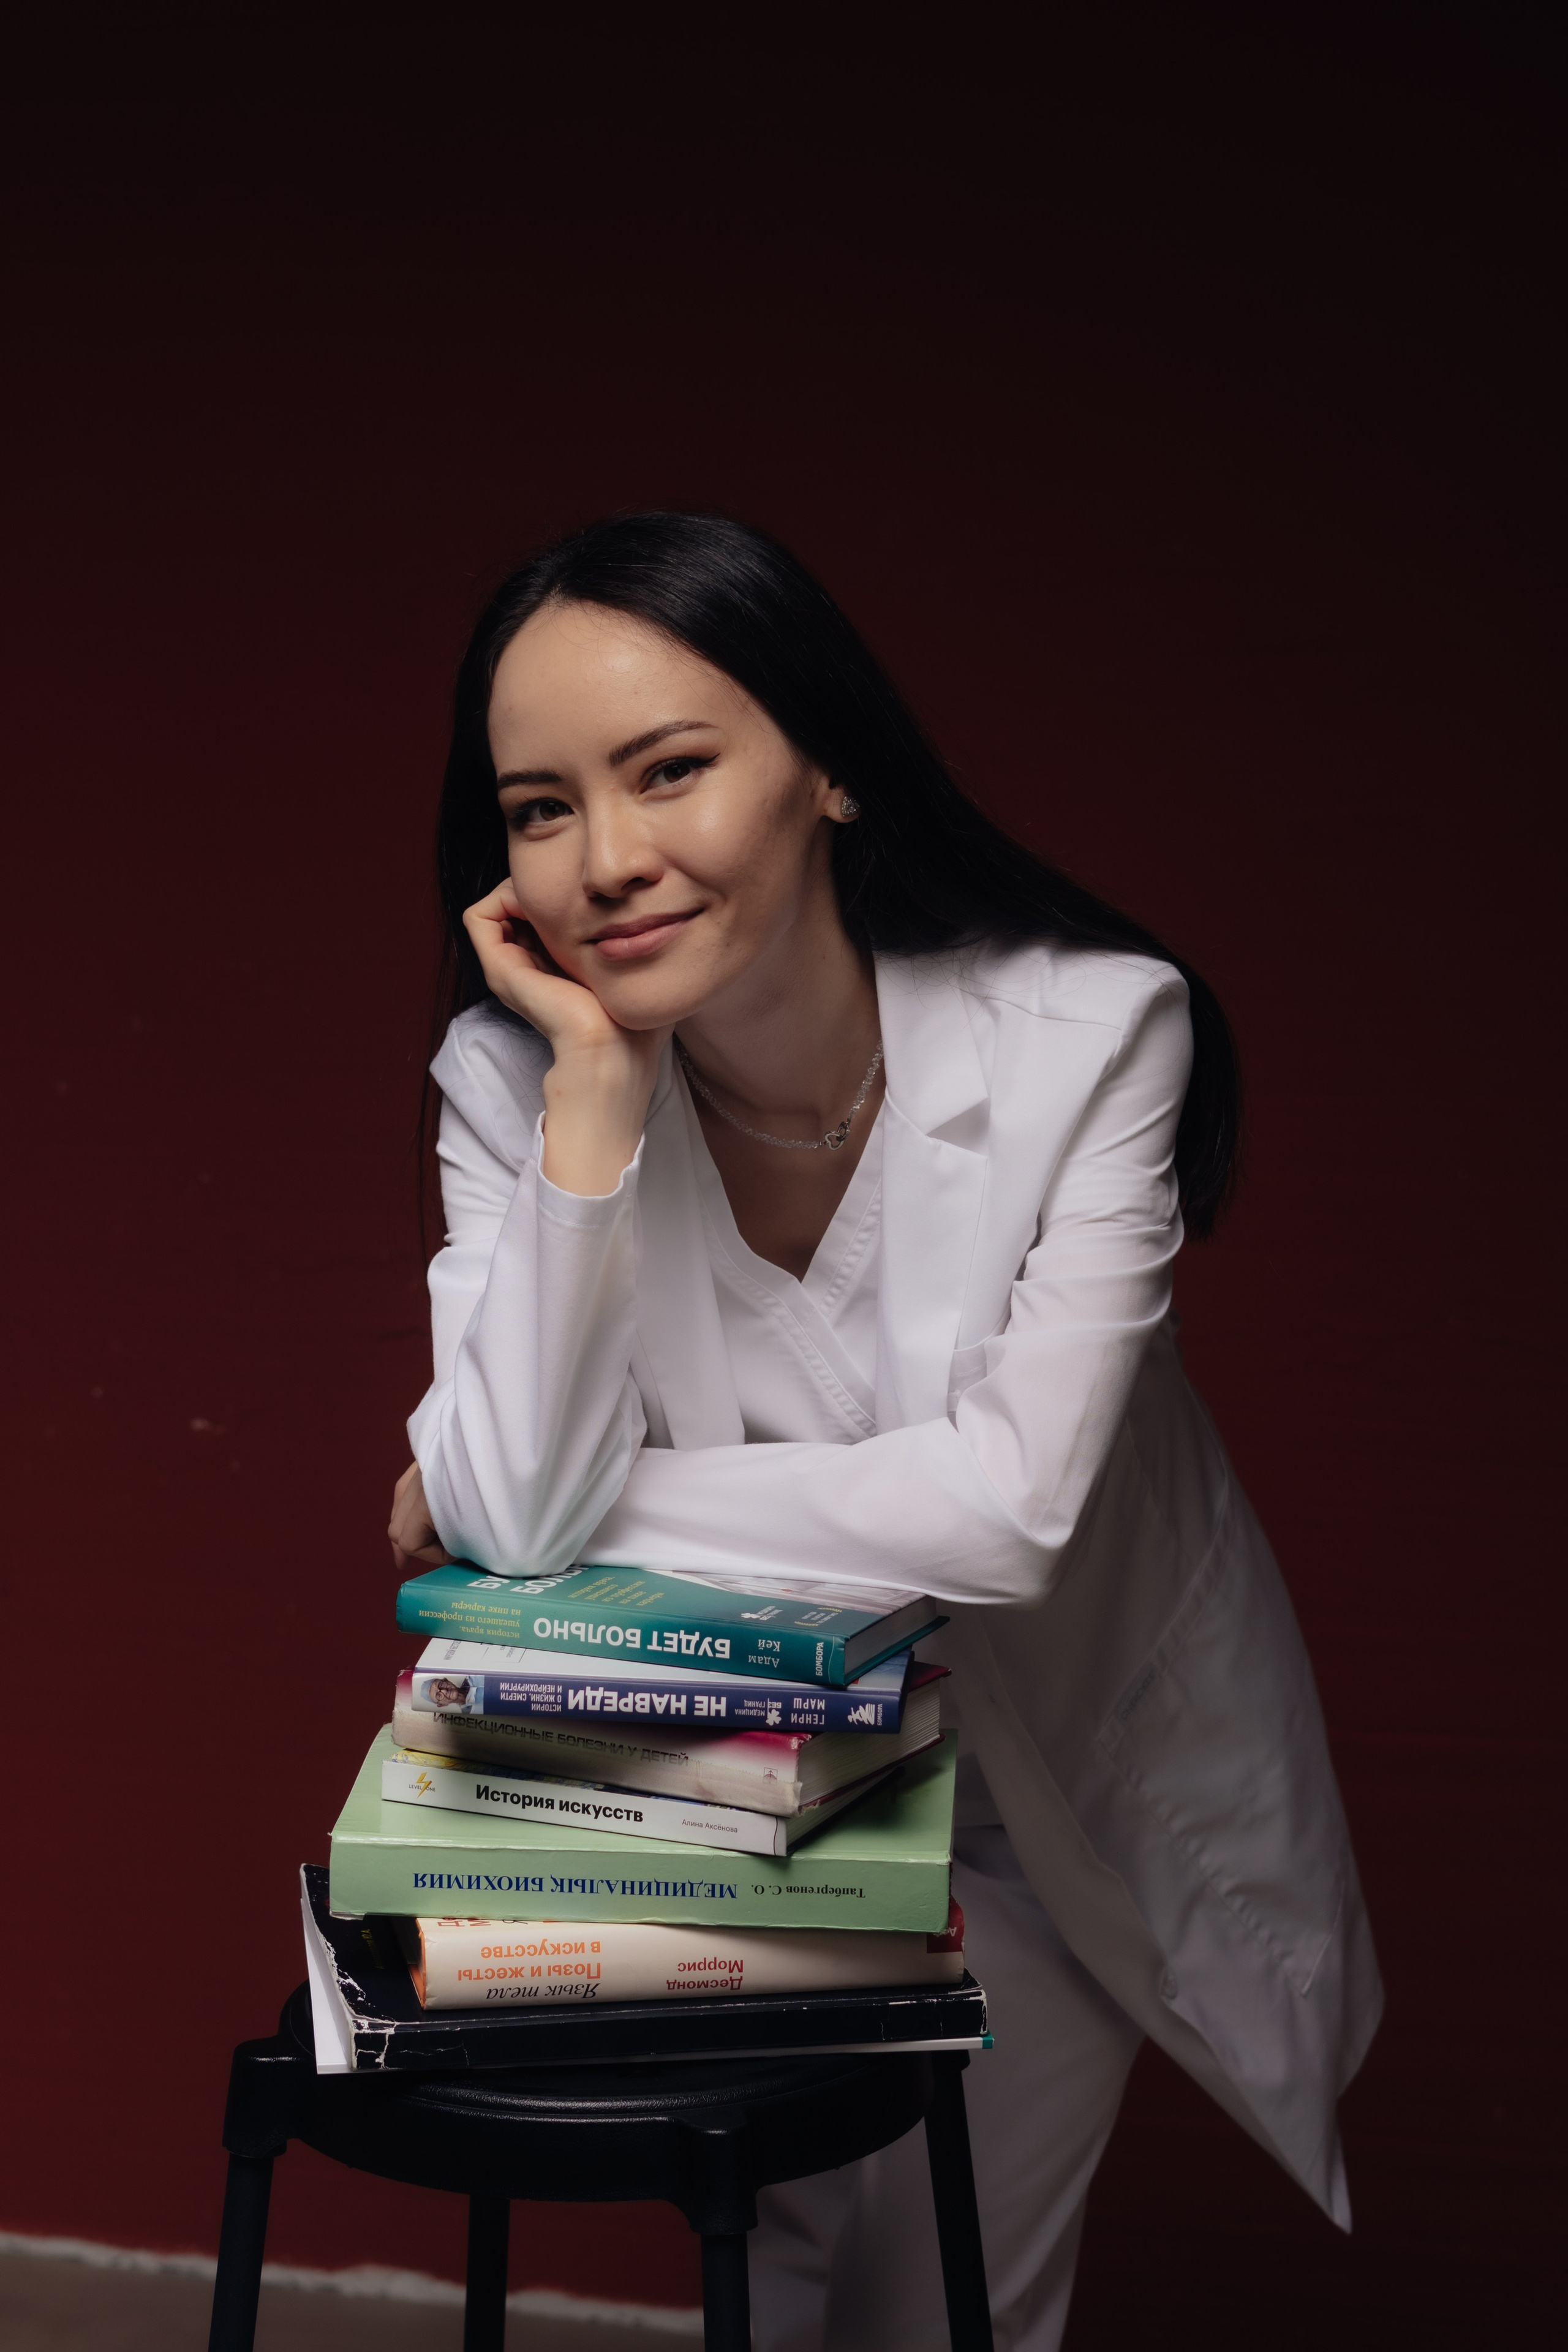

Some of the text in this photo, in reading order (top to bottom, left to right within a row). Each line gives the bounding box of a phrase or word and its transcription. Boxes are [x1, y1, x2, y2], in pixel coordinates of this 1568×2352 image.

[451, 1601, 486, 1612] карьеры
[418, 1610, 463, 1621] профессии
[477, 1617, 520, 1627] ушедшего
[486, 1629, 520, 1638] история
[533, 1617, 731, 1659] БУДЕТ БОЛЬНО
[757, 1639, 781, 1652] Кей
[748, 1654, 780, 1668] Адам
[815, 1642, 824, 1676] БОМБОРА
[500, 1682, 555, 1694] НЕЙРОХИРУРГИИ
[500, 1692, 527, 1701] СМЕРТИ
[529, 1693, 555, 1702] ЖИЗНИ,
[568, 1686, 726, 1716] НЕ НАВРЕДИ
[531, 1703, 562, 1712] ИСТОРИИ
[793, 1698, 825, 1710] МАРШ
[791, 1713, 824, 1725] ГЕНРИ
[433, 1712, 690, 1766] ИНФЕКЦИОННЫЕ БОЛЕЗНИ У ДЕТЕЙ
[476, 1784, 643, 1822] История искусств
[682, 1819, 737, 1833] Алина Аксёнова
[413, 1872, 738, 1898] МЕДИЦИНАЛЫҚ БИОХИМИЯ
[751, 1883, 865, 1898] Тапбергенов С. О.
[481, 1939, 601, 1959] в искусстве
[458, 1963, 601, 1981] Позы и жесты
[677, 1957, 744, 1973] Моррис
[666, 1976, 743, 1991] Десмонд
[486, 1983, 600, 2000] Язык тела
